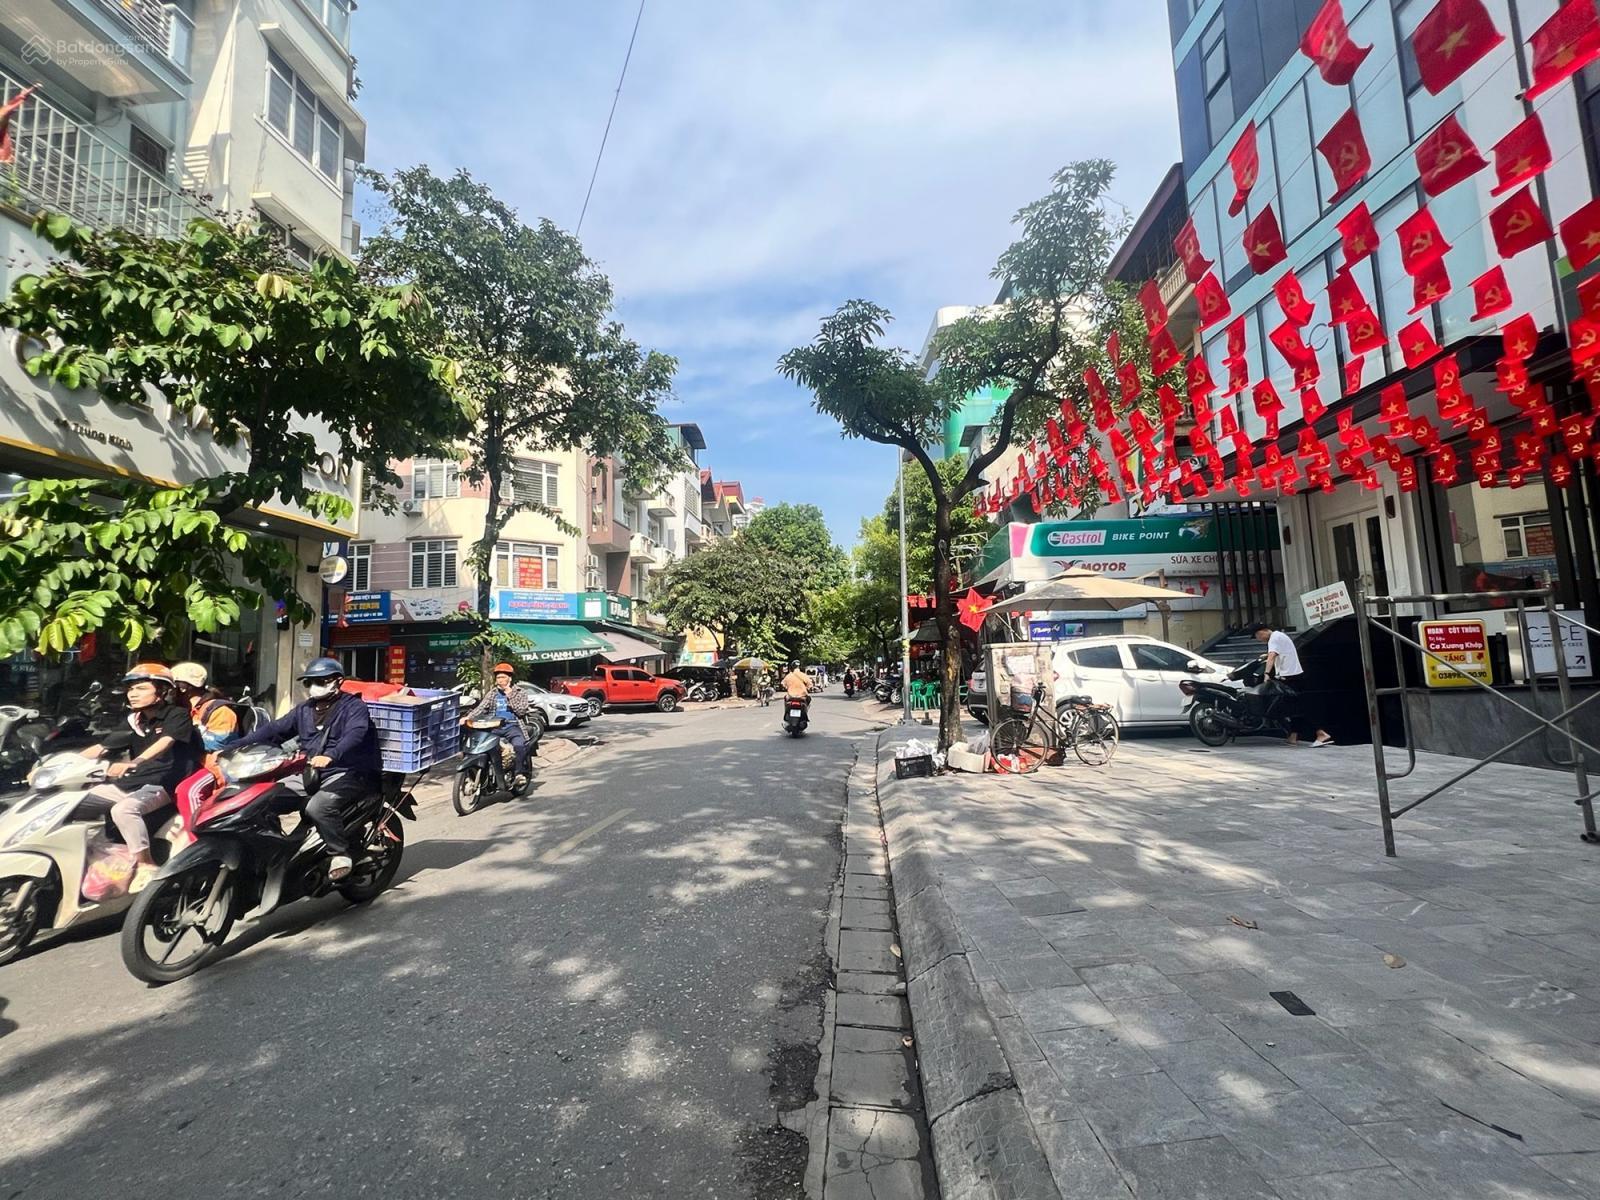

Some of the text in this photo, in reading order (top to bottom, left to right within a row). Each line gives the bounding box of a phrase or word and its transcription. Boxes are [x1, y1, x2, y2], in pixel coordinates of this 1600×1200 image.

[1061, 531, 1171, 545] Castrol BIKE POINT
[1170, 555, 1189, 564] SỬA
[1190, 555, 1202, 564] XE
[521, 653, 539, 661] TRÀ
[541, 650, 573, 660] CHANH
